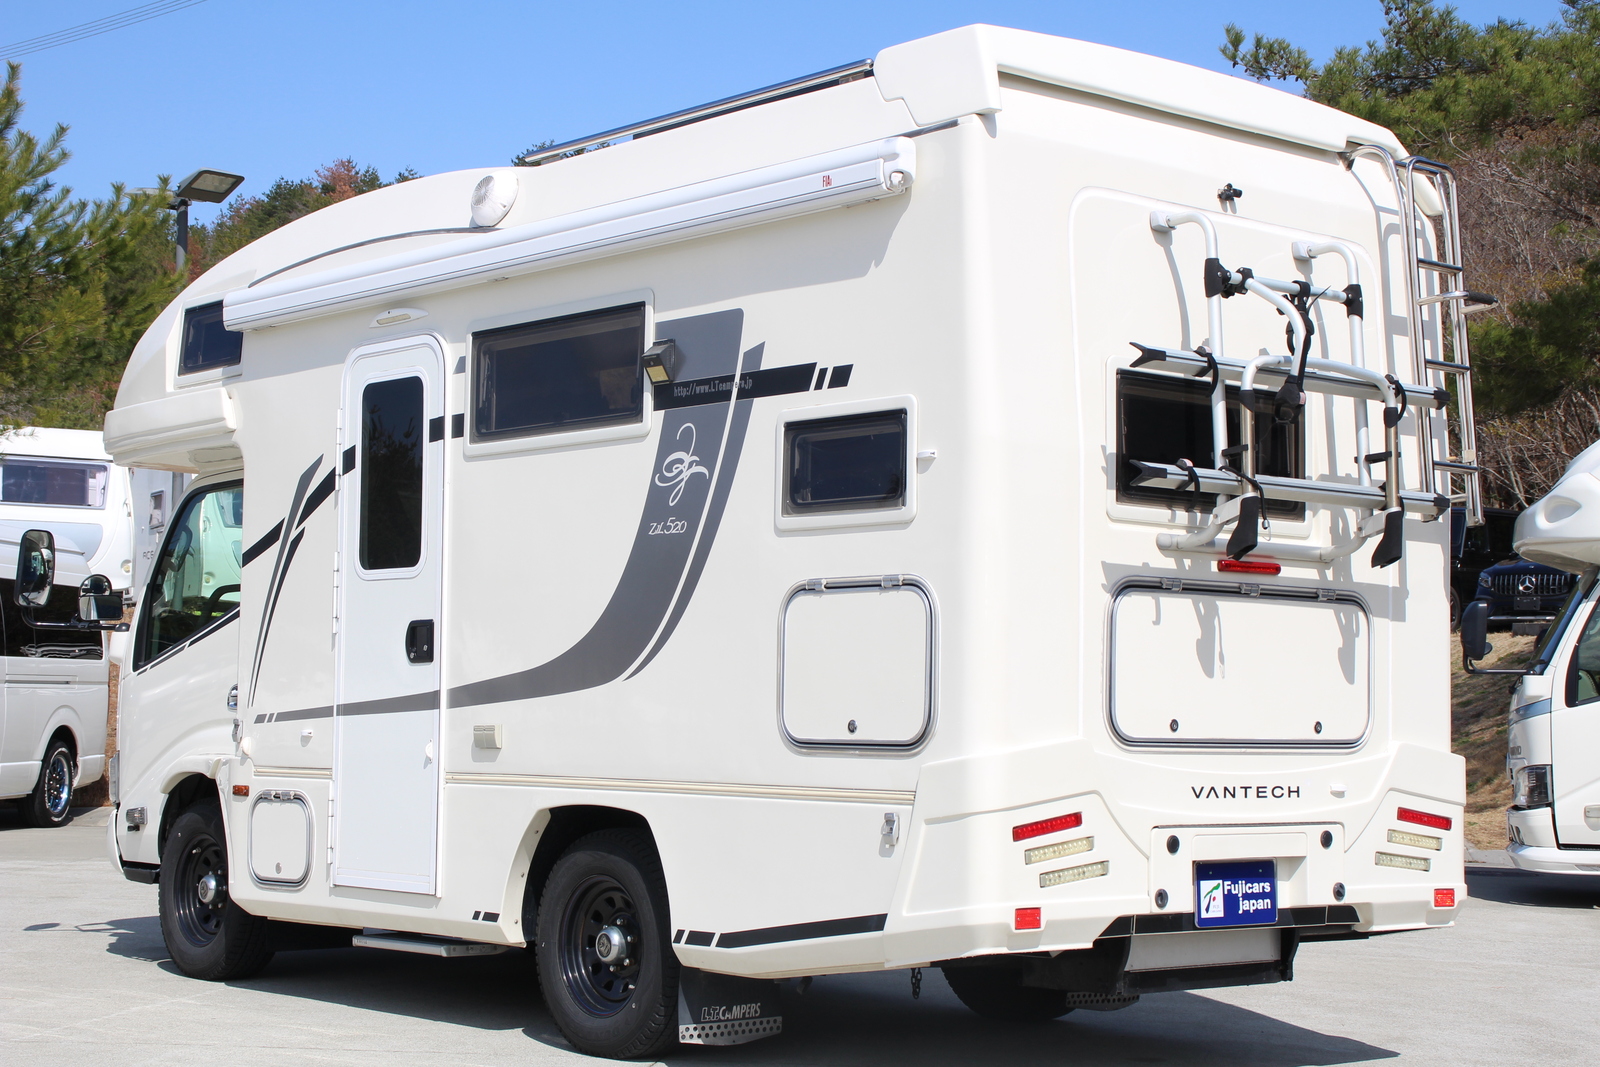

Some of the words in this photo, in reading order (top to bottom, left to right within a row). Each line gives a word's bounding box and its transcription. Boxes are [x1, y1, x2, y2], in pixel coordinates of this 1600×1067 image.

[1191, 785, 1300, 799] VANTECH
[1223, 880, 1271, 897] Fujicars
[1238, 896, 1272, 914] japan
